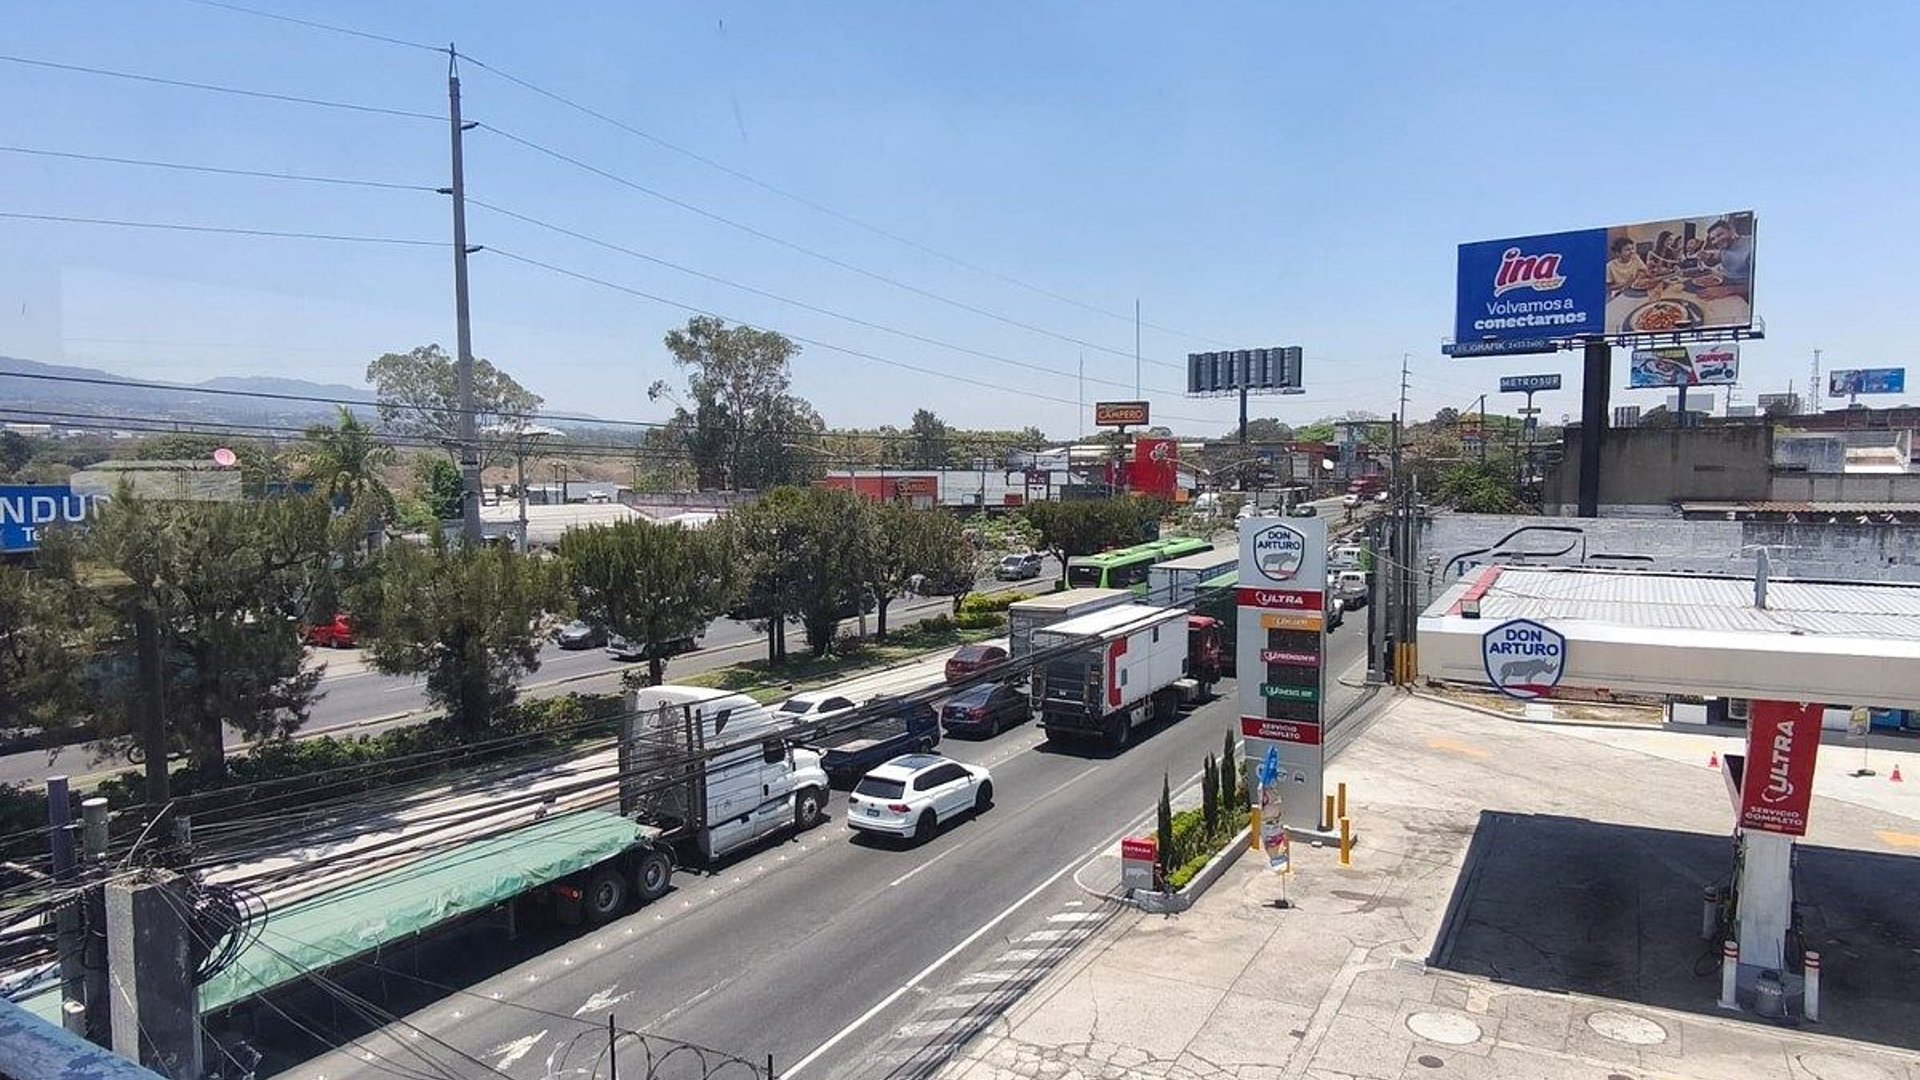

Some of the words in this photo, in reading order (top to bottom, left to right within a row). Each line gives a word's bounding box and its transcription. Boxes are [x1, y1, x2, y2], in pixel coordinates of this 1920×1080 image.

[1495, 248, 1562, 289] ina
[1487, 299, 1561, 315] Volvamos
[1563, 298, 1574, 309] a
[1474, 312, 1587, 330] conectarnos
[1501, 376, 1559, 387] METROSUR
[1098, 408, 1143, 419] CAMPERO
[1268, 531, 1291, 540] DON
[1257, 541, 1301, 550] ARTURO
[1257, 591, 1304, 605] ULTRA
[1505, 629, 1543, 642] DON
[1489, 642, 1559, 656] ARTURO
[1262, 723, 1298, 732] SERVICIO
[1258, 729, 1301, 740] COMPLETO
[1763, 720, 1795, 801] ULTRA
[1750, 805, 1800, 818] SERVICIO
[1745, 812, 1803, 826] COMPLETO
